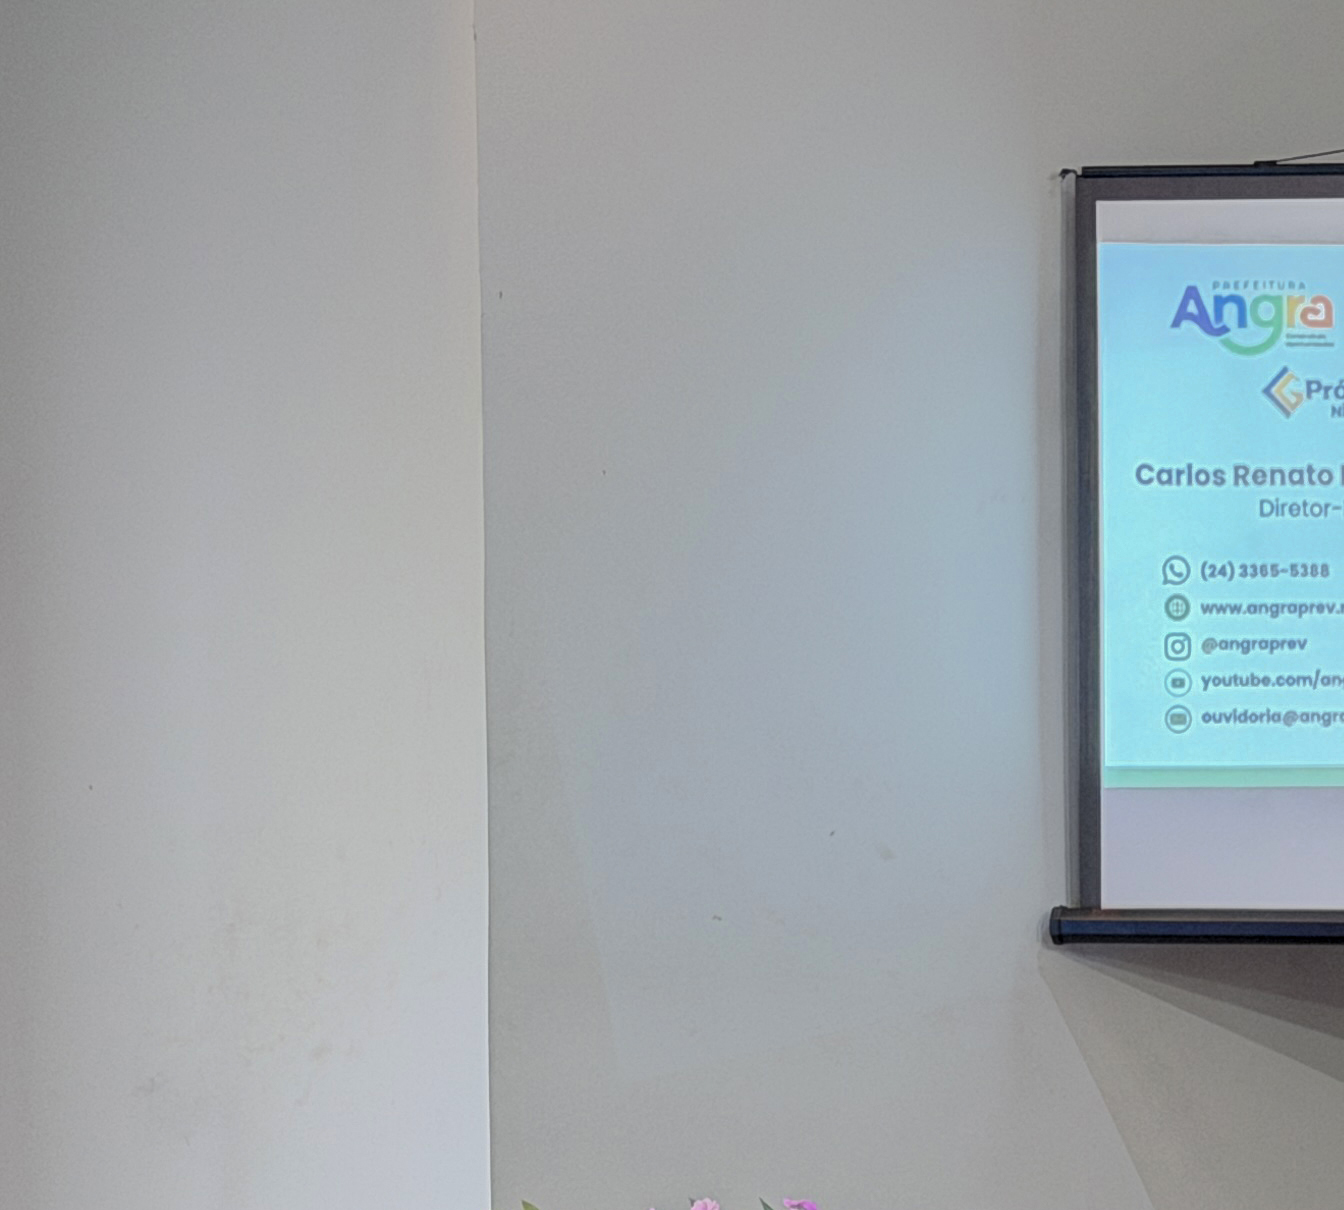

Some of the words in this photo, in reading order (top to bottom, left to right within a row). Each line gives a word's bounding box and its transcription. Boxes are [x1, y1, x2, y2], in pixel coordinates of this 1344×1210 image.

[1170, 285, 1334, 356] Angra
[1135, 463, 1226, 487] Carlos
[1233, 463, 1334, 487] Renato
[1200, 560, 1235, 582] (24)
[1201, 637, 1308, 655] @angraprev
